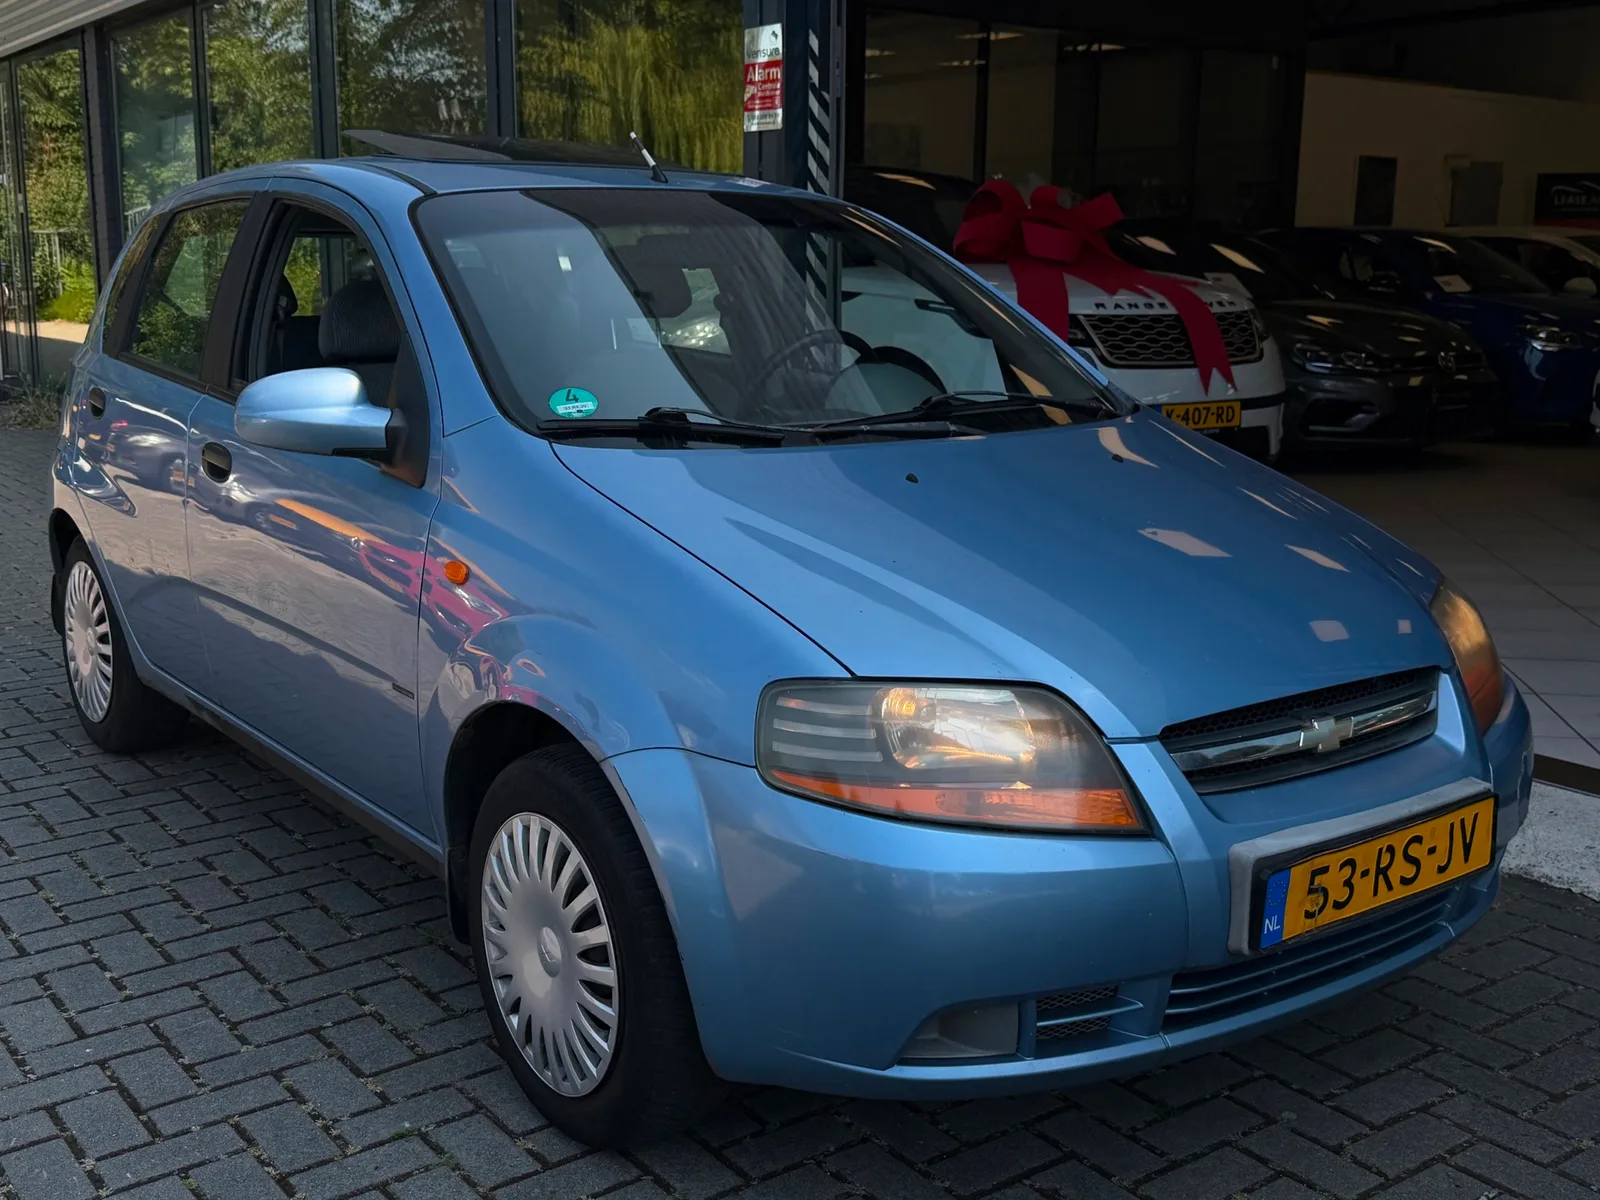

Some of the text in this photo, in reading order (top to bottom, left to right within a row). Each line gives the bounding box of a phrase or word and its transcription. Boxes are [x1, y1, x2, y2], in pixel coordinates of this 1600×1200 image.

[746, 65, 781, 82] Alarm
[1094, 302, 1168, 310] RANGE
[566, 389, 579, 402] 4
[1166, 406, 1236, 426] K-407-RD
[1303, 811, 1480, 920] 53-RS-JV
[1263, 914, 1281, 935] NL
